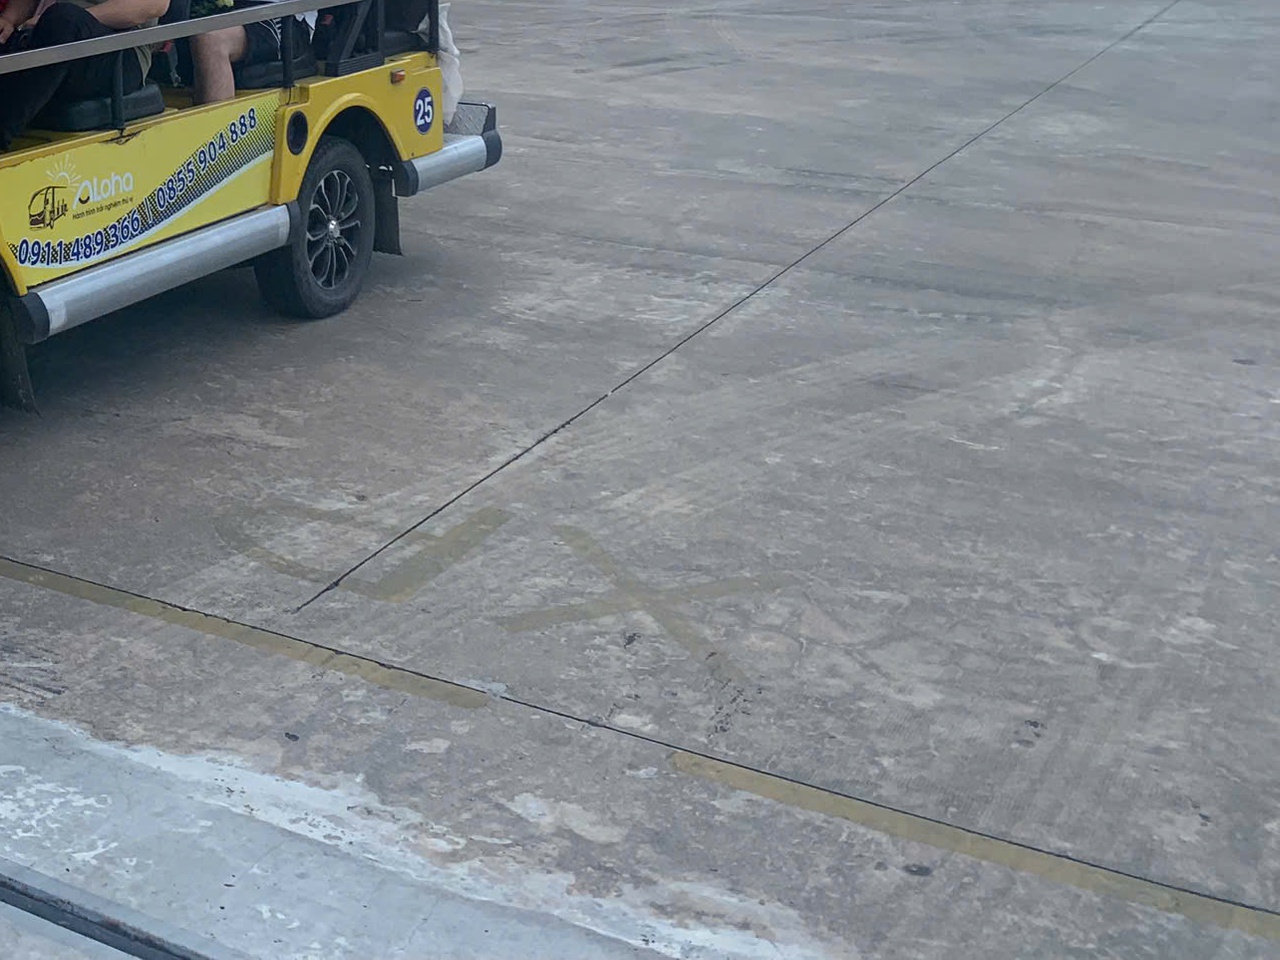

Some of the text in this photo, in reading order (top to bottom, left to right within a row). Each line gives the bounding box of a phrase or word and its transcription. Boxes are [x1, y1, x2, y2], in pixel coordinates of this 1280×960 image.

[415, 96, 434, 126] 25
[18, 239, 65, 266] 0911
[71, 230, 104, 262] 489
[108, 210, 141, 248] 366
[156, 161, 196, 210] 0855
[198, 132, 227, 171] 904
[230, 107, 257, 144] 888
